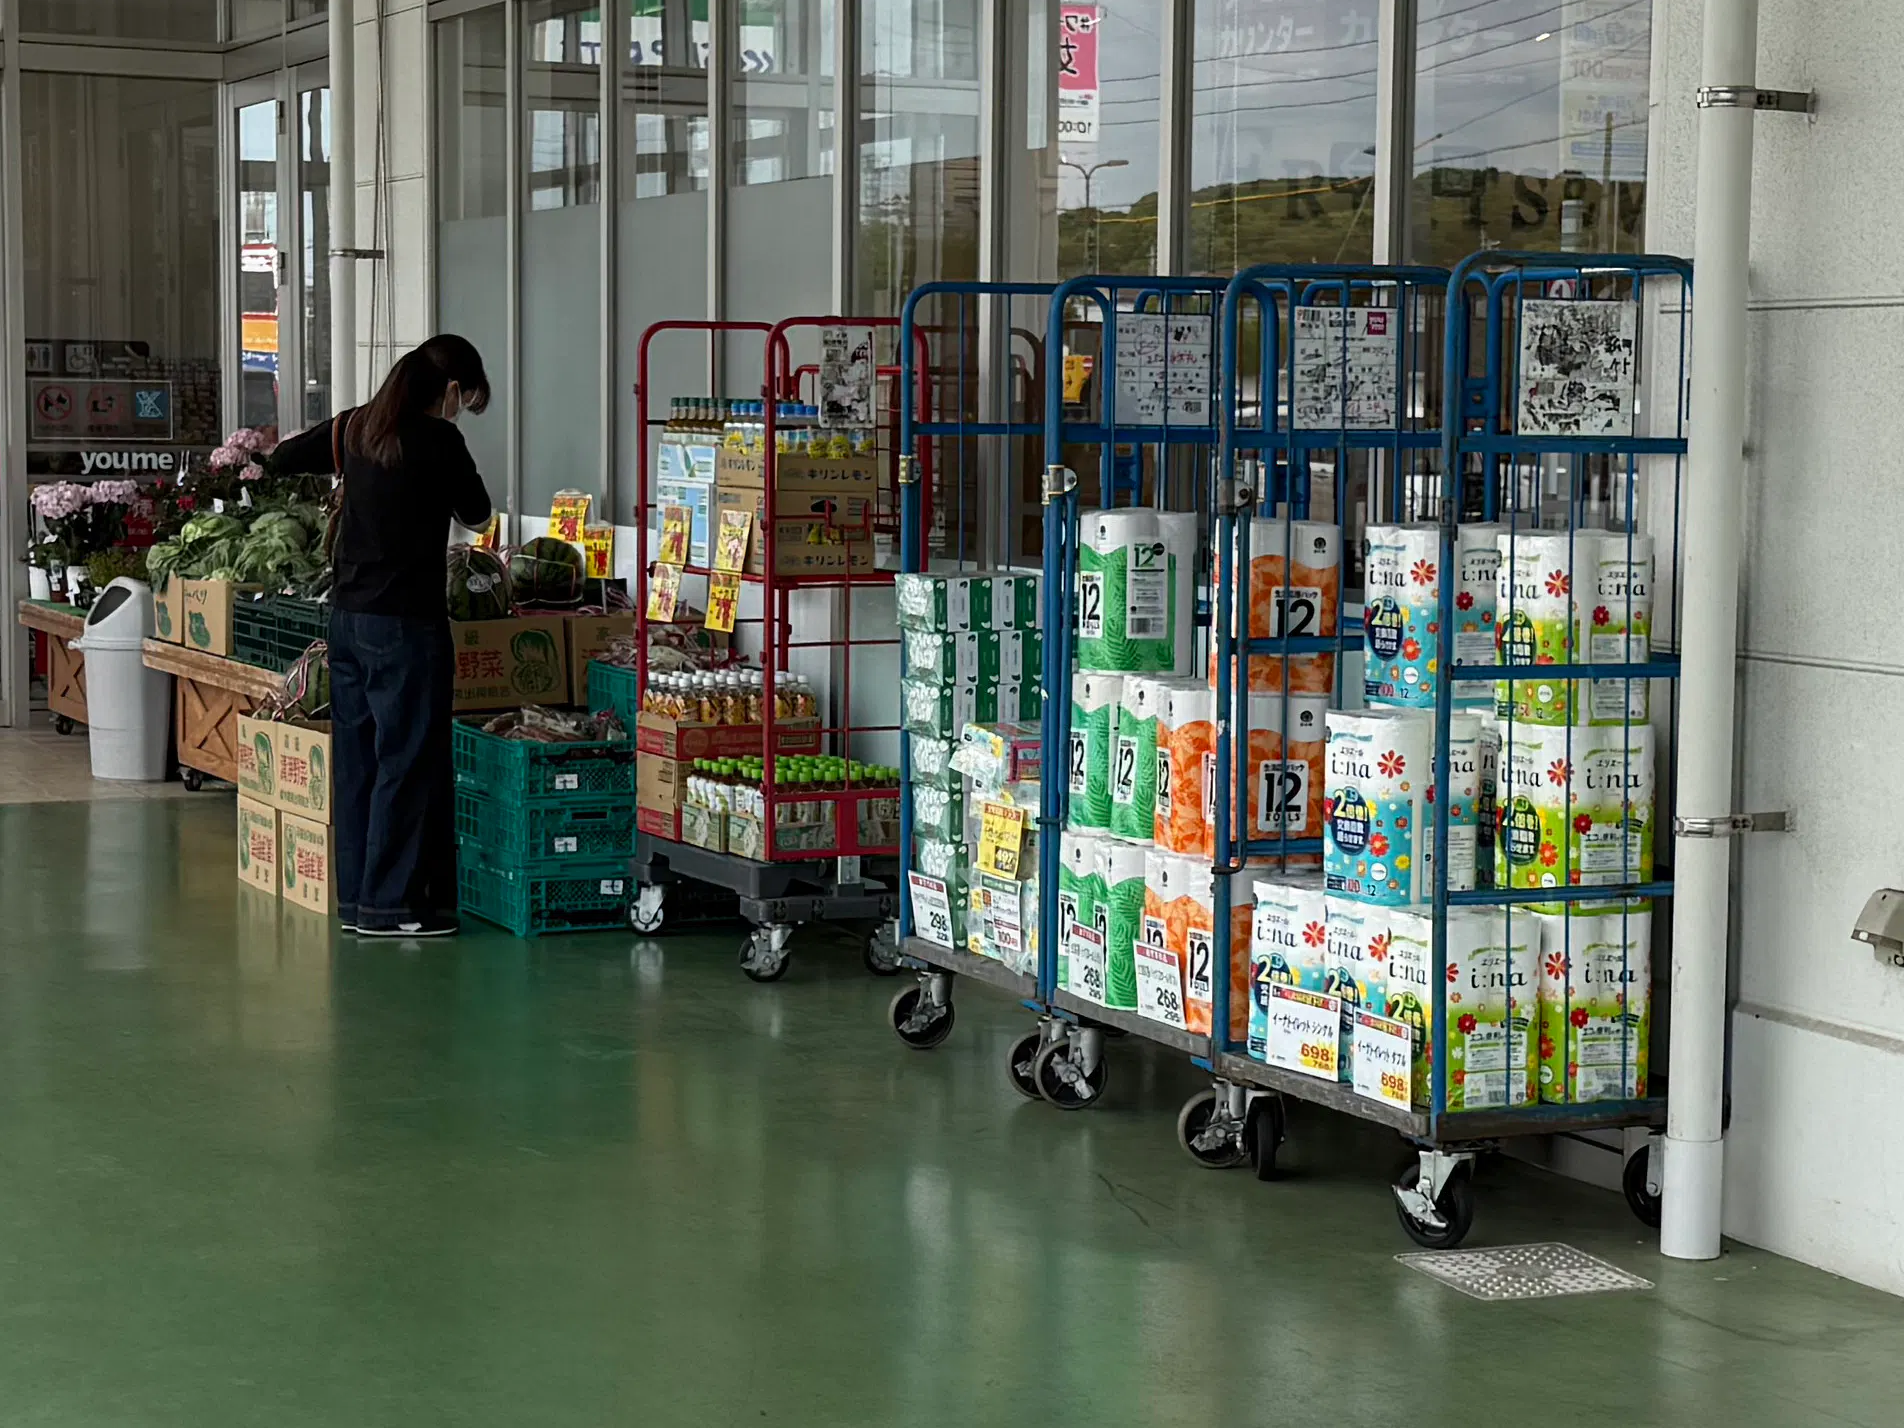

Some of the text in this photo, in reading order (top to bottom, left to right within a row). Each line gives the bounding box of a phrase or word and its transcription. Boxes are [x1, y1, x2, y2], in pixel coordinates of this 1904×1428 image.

[80, 452, 174, 475] youme
[807, 468, 872, 481] キリンレモン
[804, 555, 869, 567] キリンレモン
[1134, 547, 1156, 568] 12
[1082, 583, 1100, 621] 12
[1276, 598, 1315, 637] 12
[1118, 747, 1135, 787] 12
[1265, 772, 1302, 812] 12
[1265, 812, 1301, 822] ROLS
[1189, 940, 1210, 981] 12
[1156, 987, 1178, 1011] 268
[1301, 1043, 1330, 1063] 698
